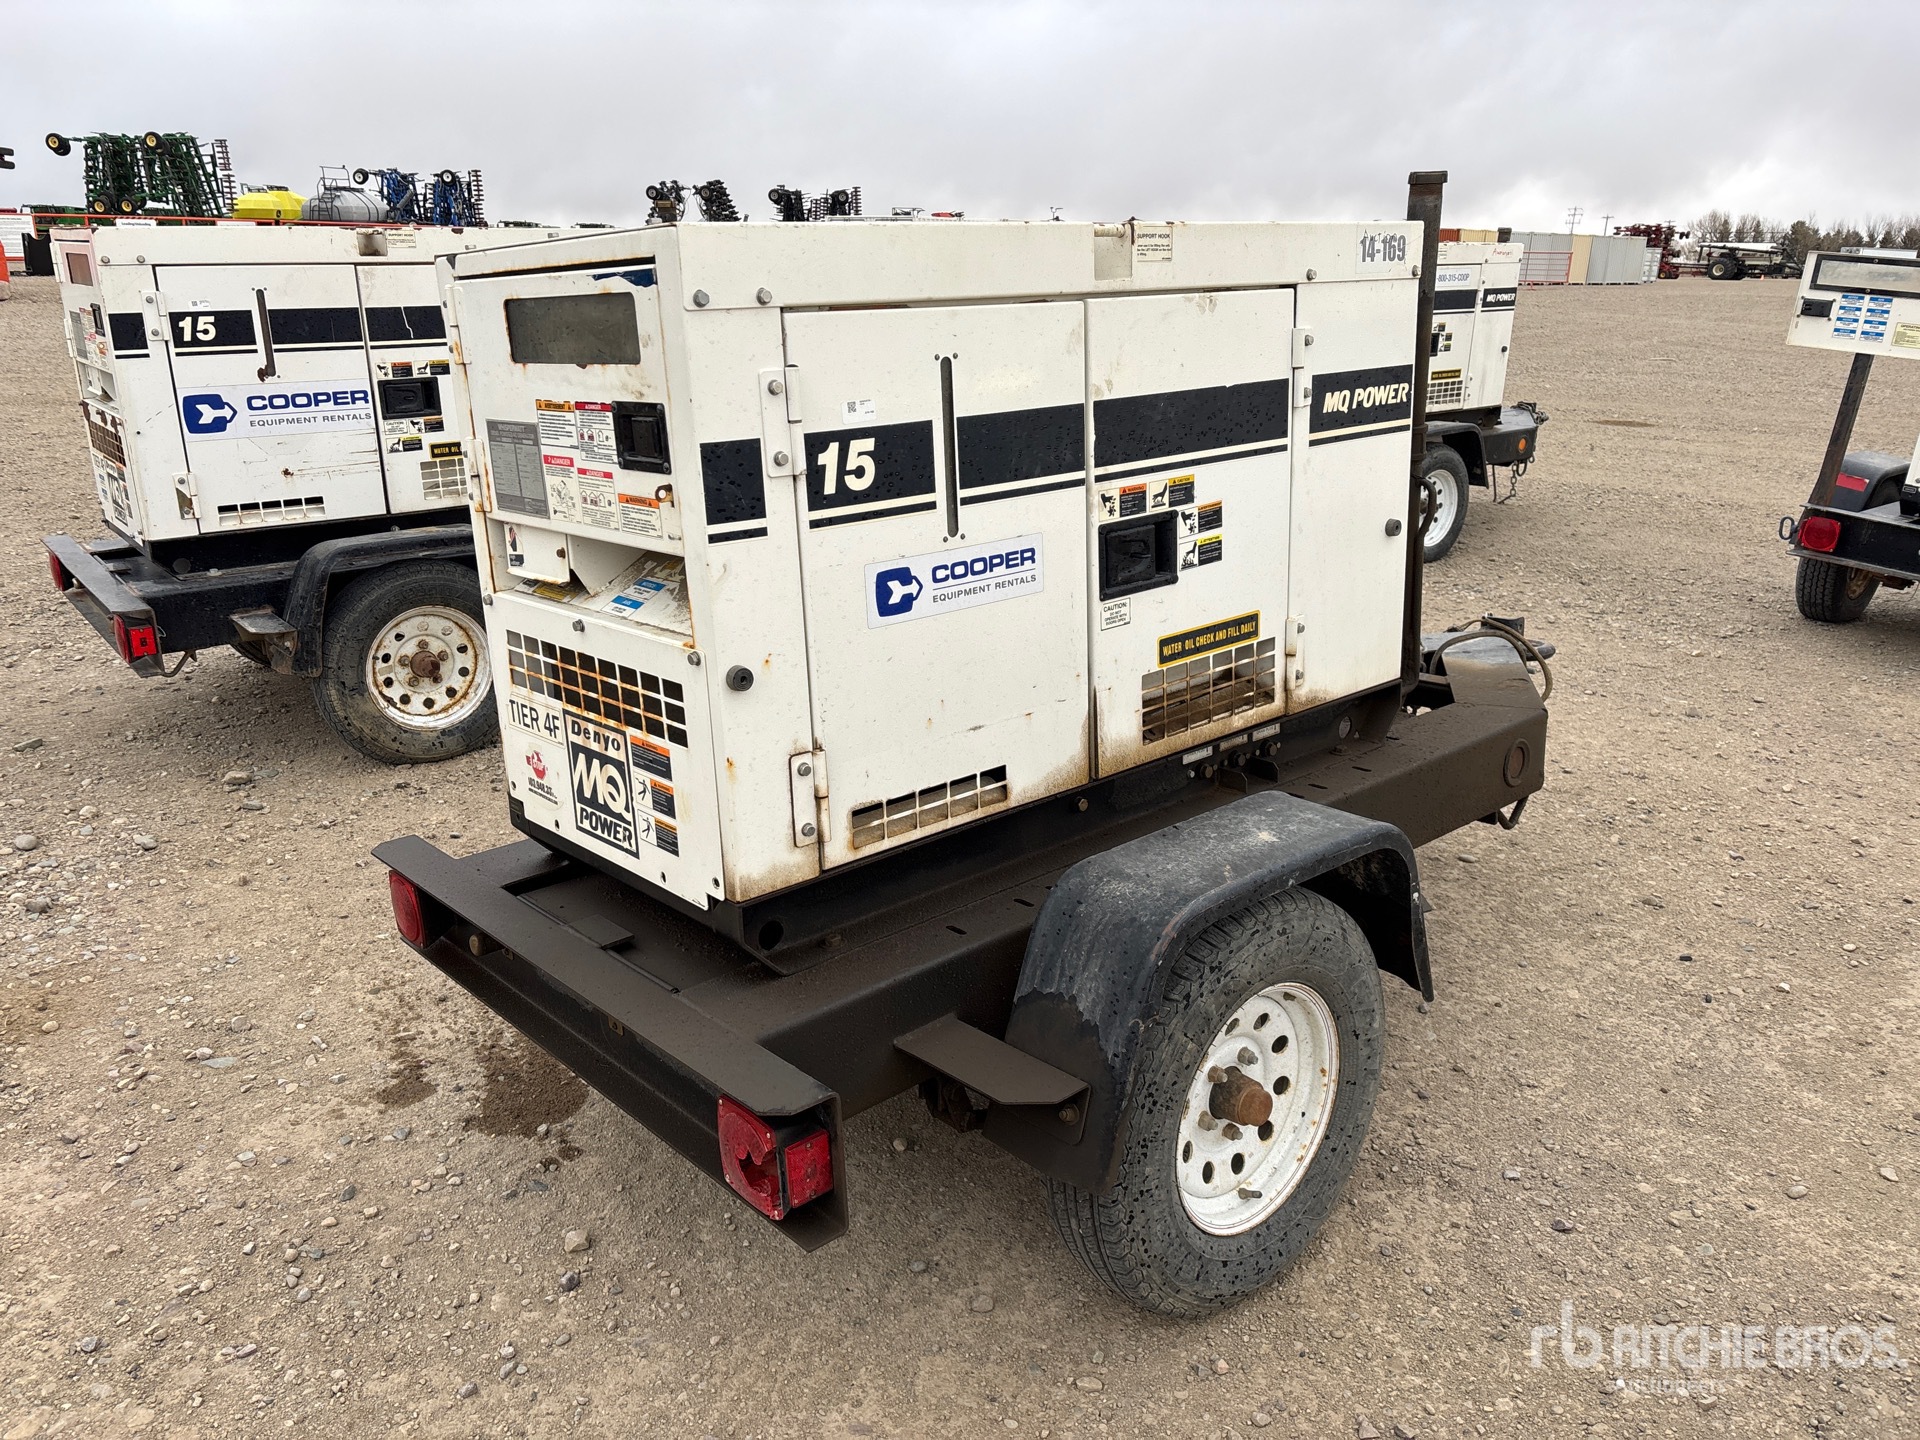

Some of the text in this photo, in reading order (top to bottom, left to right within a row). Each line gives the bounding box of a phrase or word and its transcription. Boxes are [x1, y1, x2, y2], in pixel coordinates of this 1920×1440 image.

[1359, 234, 1407, 263] 14-169
[1486, 293, 1516, 303] MQ POWER
[178, 315, 217, 342] 15
[246, 389, 370, 411] COOPER
[1322, 382, 1410, 414] MQ POWER
[250, 412, 372, 428] EQUIPMENT RENTALS
[817, 437, 876, 495] 15
[629, 497, 648, 506] WARNING
[931, 547, 1036, 584] COOPER
[932, 574, 1037, 603] EQUIPMENT RENTALS
[1103, 601, 1128, 613] CAUTION:
[1162, 621, 1257, 657] WATER OIL CHECK AND FILL DAILY
[508, 699, 560, 740] TIER 4F
[571, 720, 621, 752] Denyo
[574, 752, 631, 823] MQ
[579, 806, 634, 848] POWER
